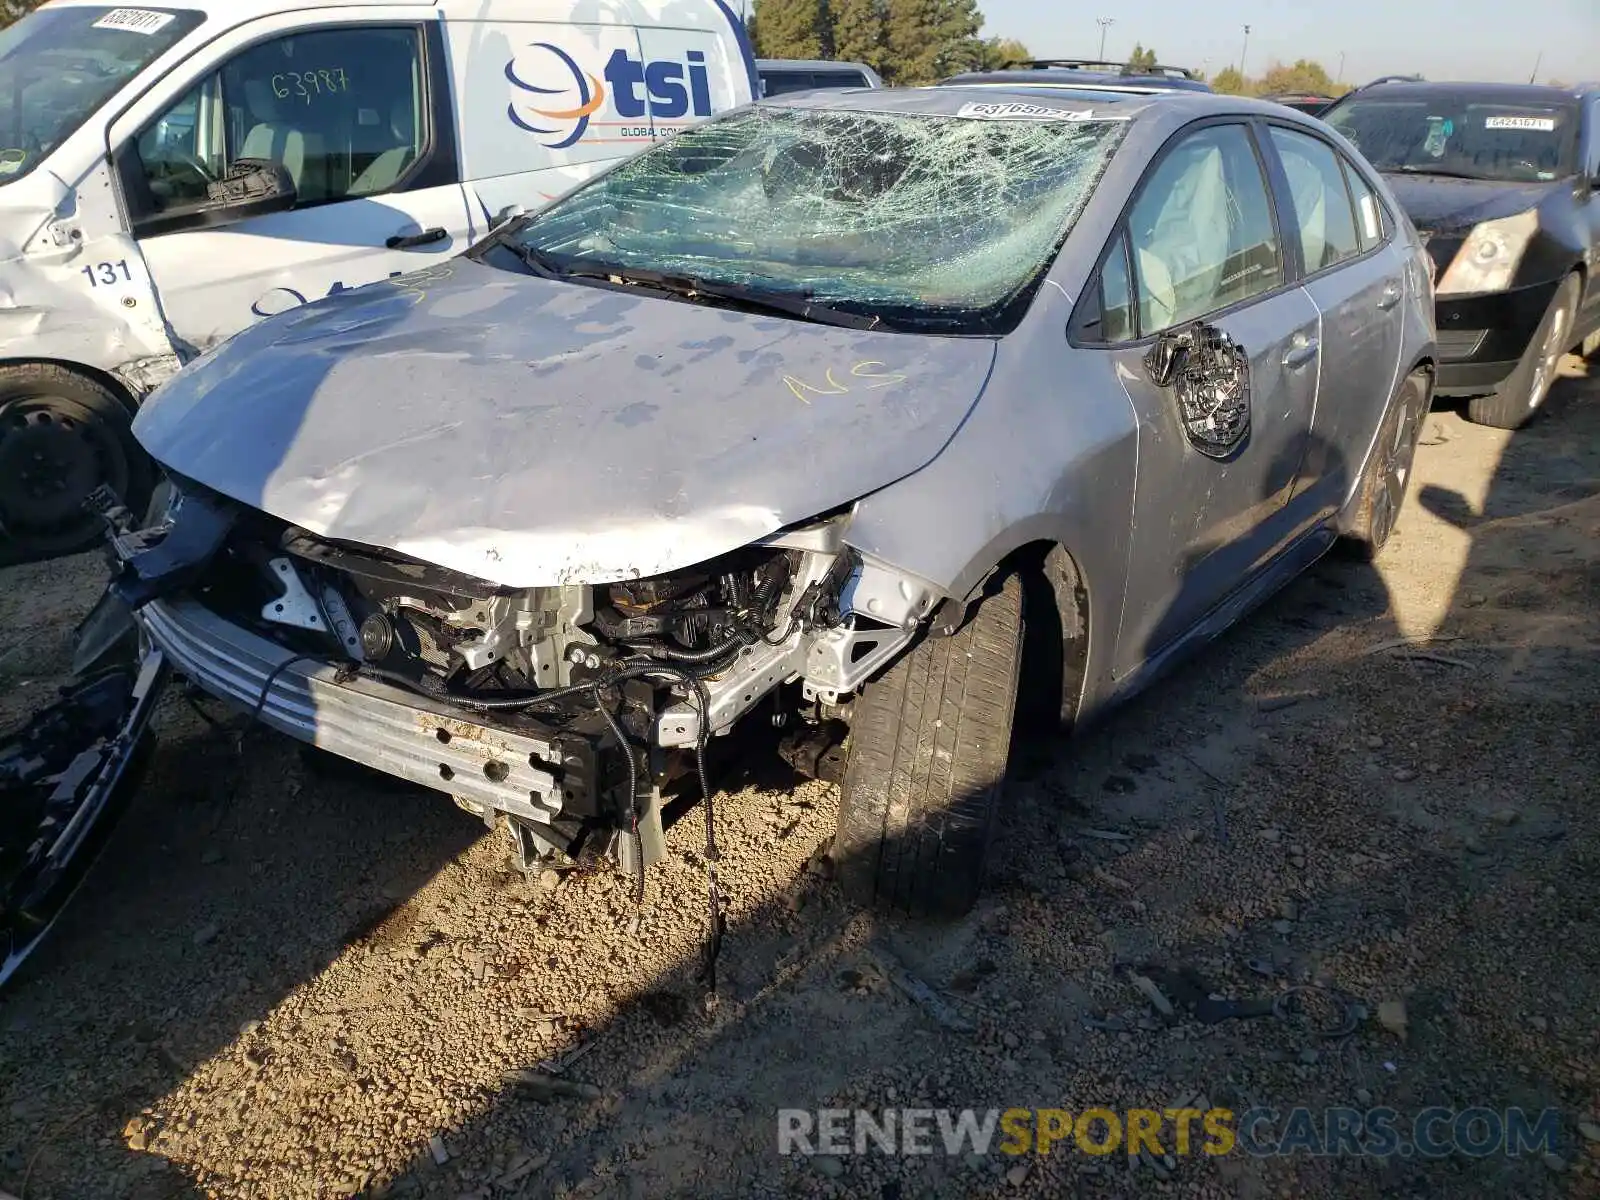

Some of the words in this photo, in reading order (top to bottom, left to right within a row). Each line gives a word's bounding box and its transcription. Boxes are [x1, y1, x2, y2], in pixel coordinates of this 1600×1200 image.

[272, 68, 348, 105] 63,987
[604, 49, 712, 118] tsi
[621, 127, 657, 137] GLOBAL
[81, 259, 131, 287] 131
